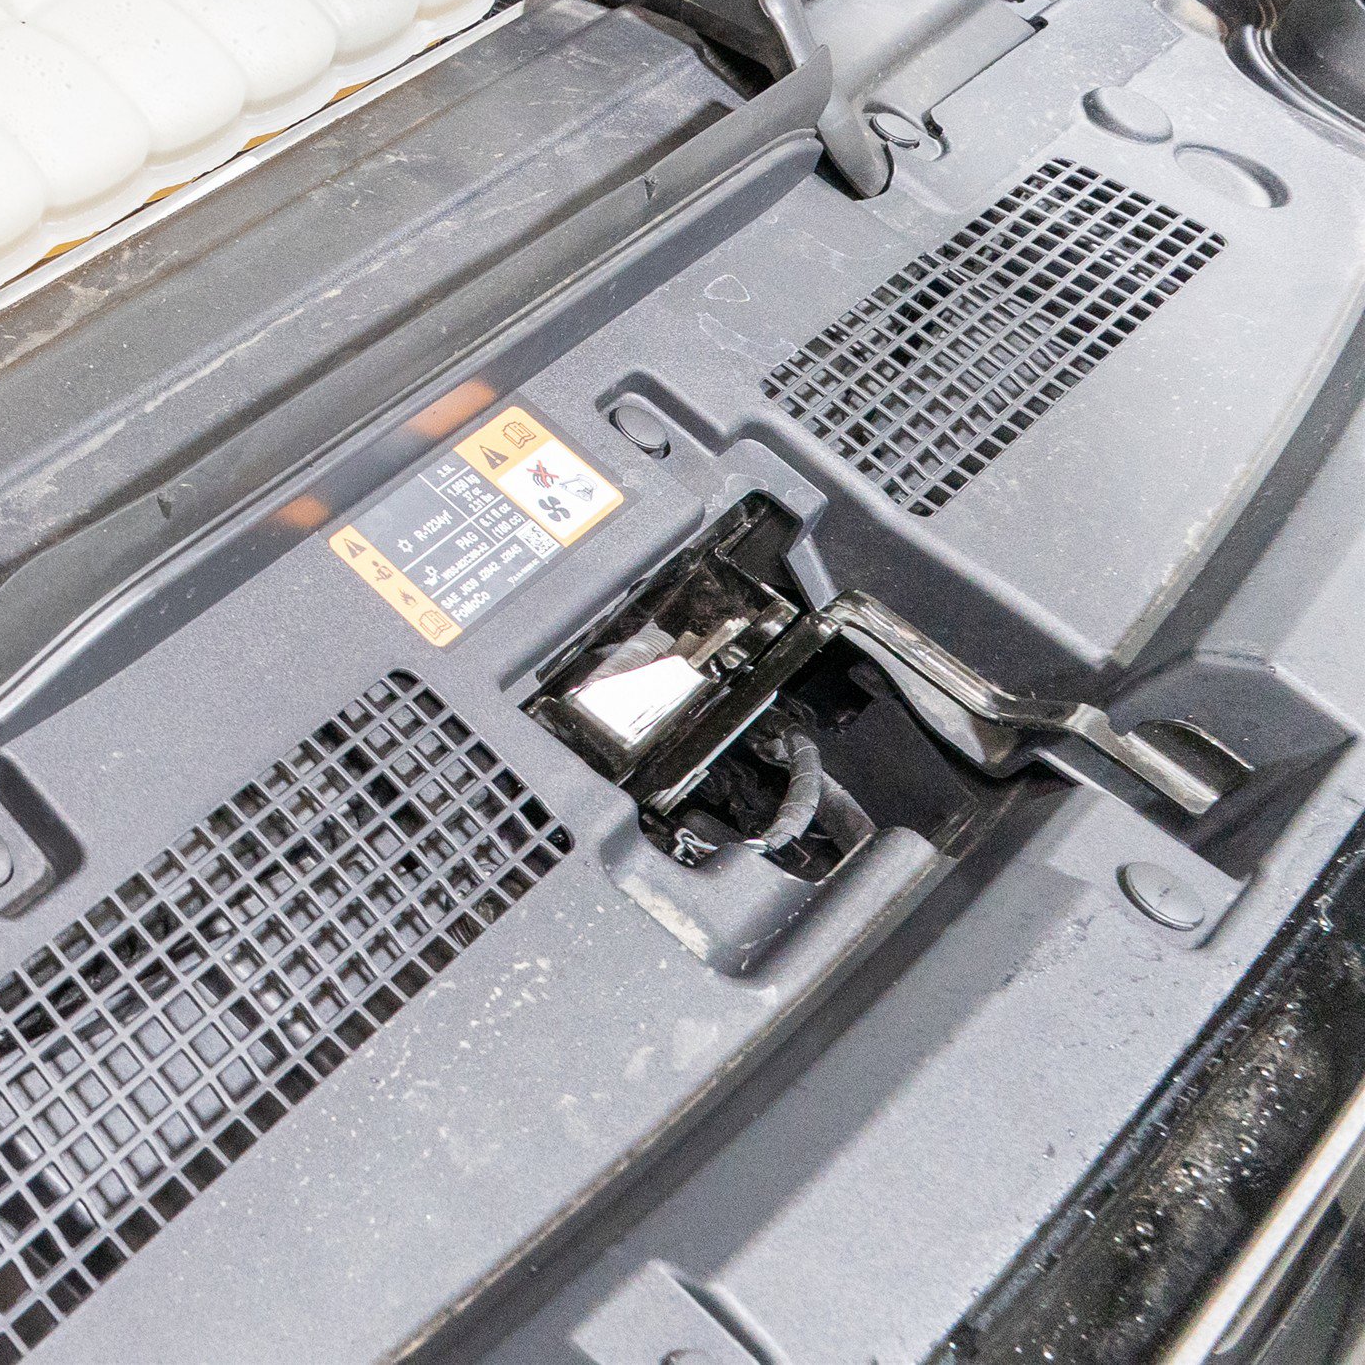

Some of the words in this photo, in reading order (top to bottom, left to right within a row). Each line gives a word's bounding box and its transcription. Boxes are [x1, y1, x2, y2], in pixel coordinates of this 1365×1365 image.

[436, 461, 456, 480] 3.5L
[464, 470, 482, 489] kg
[462, 489, 476, 503] 37
[412, 507, 455, 545] R-1234yf
[478, 511, 496, 530] 6.1
[497, 501, 512, 516] oz
[508, 510, 526, 528] cc)
[454, 528, 480, 552] PAG
[439, 589, 462, 611] SAE
[450, 586, 492, 623] FoMoCo
